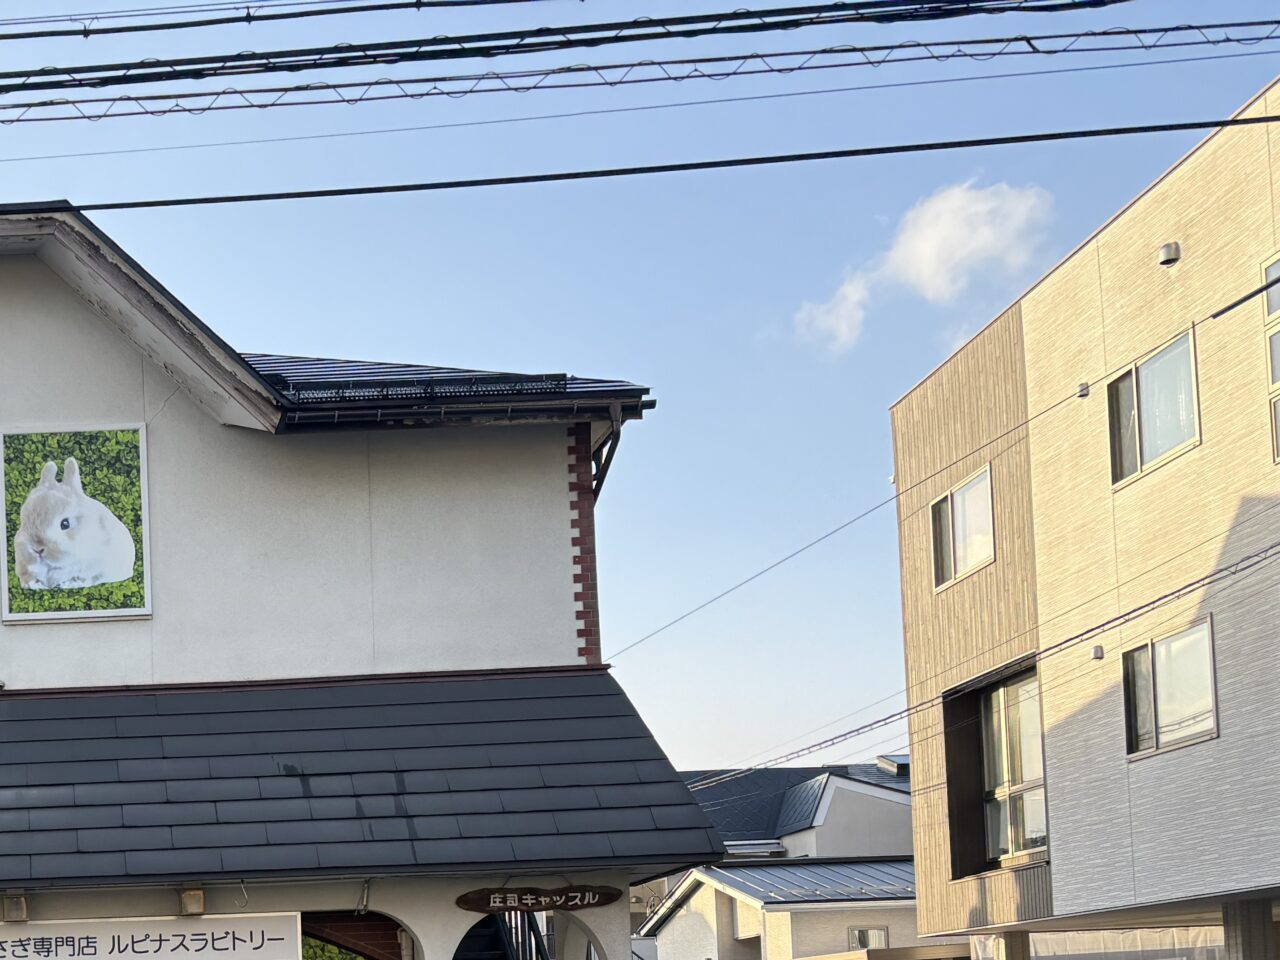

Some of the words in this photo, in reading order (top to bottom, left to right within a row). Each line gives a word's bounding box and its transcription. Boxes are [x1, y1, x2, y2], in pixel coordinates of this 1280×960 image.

[489, 891, 599, 908] 庄司キャッスル
[108, 929, 285, 955] ルピナスラビトリー
